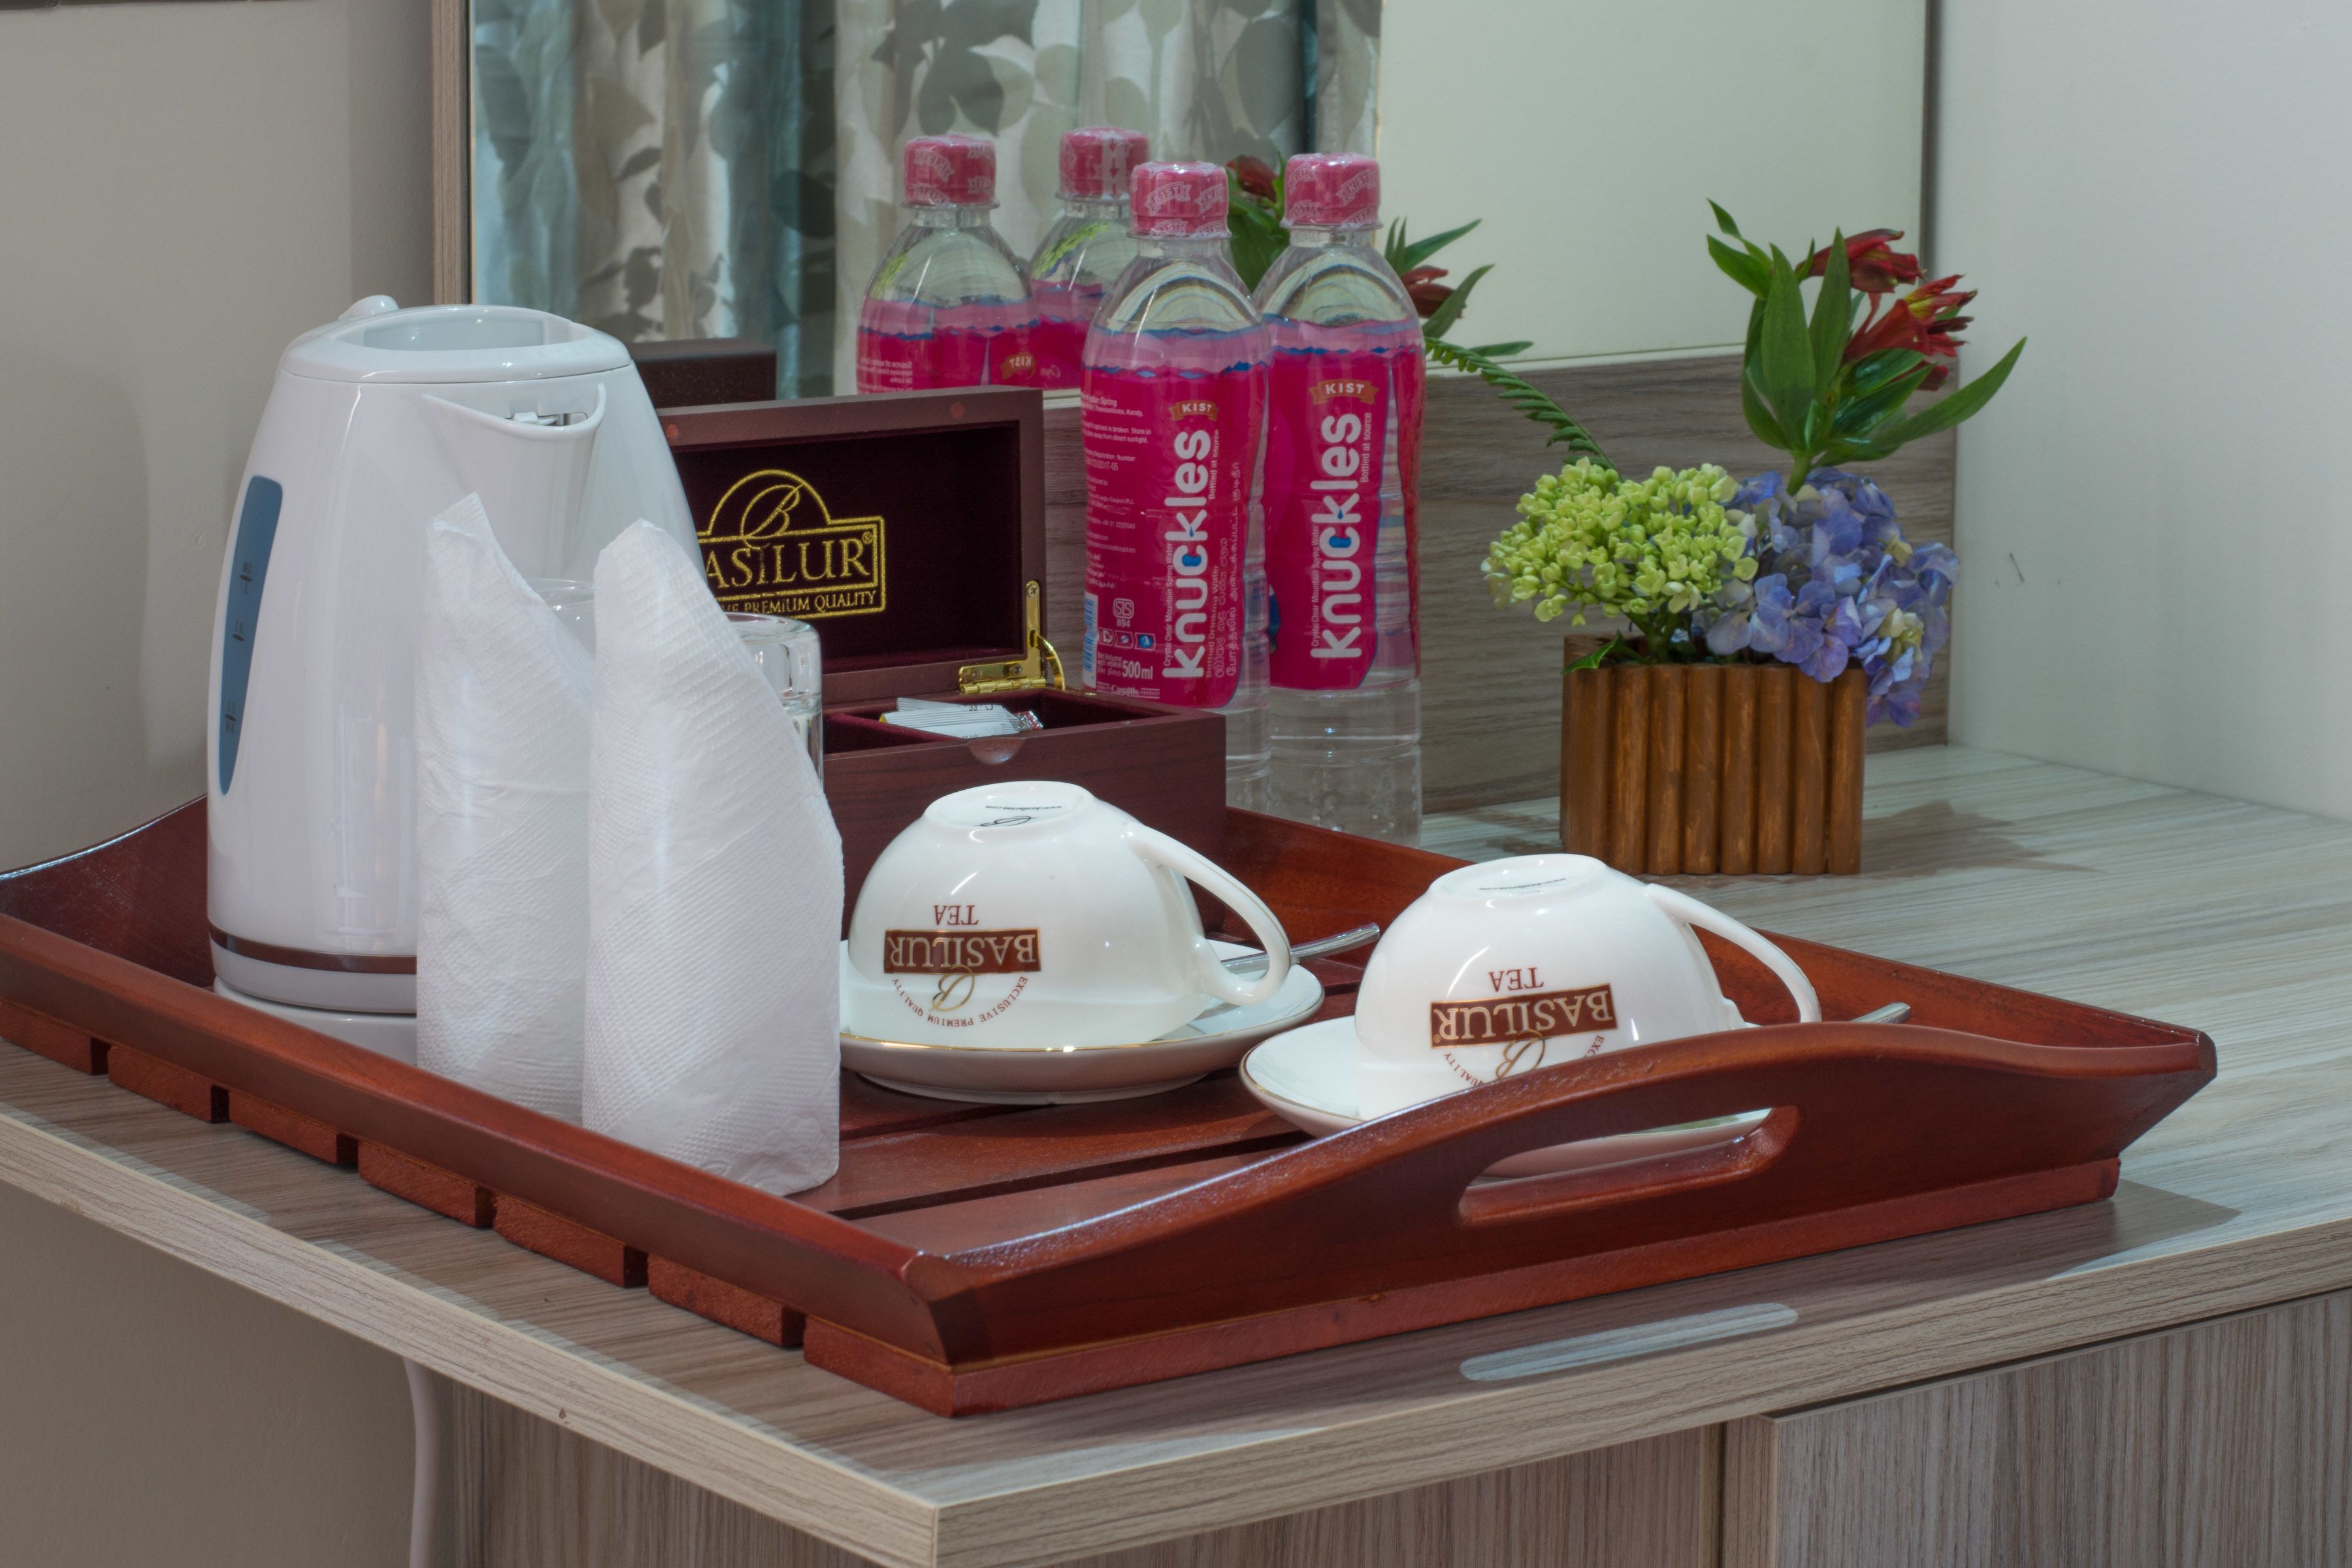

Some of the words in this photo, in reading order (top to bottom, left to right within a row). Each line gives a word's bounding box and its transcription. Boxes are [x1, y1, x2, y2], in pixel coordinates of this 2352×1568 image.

[1156, 186, 1180, 203] KIST
[1348, 174, 1369, 192] KIST
[1325, 383, 1365, 394] KIST
[1100, 397, 1117, 408] Spring
[1183, 402, 1212, 412] KIST
[1362, 442, 1370, 452] at
[1211, 459, 1217, 468] at
[1360, 453, 1370, 483] Bottled
[1208, 470, 1217, 500] Bottled
[1309, 414, 1362, 658] knuckles
[706, 537, 871, 589] ASILUR
[1162, 429, 1211, 678] knuckles
[1312, 547, 1321, 569] Spring
[1166, 566, 1174, 587] Spring
[745, 597, 810, 614] PREMIUM
[814, 590, 877, 614] QUALITY
[1208, 595, 1218, 640] Drinking
[1311, 623, 1320, 647] Crystal
[1163, 642, 1172, 666] Crystal
[1206, 642, 1215, 678] Bottled
[1122, 660, 1154, 680] 500ml
[934, 905, 979, 926] TEA
[887, 934, 1037, 967] BASILUR
[1488, 967, 1544, 992] TEA
[892, 977, 924, 1017] QUALITY
[980, 975, 1028, 1023] EXCLUSIVE
[927, 1013, 975, 1028] PREMIUM
[1433, 990, 1614, 1040] BASILUR
